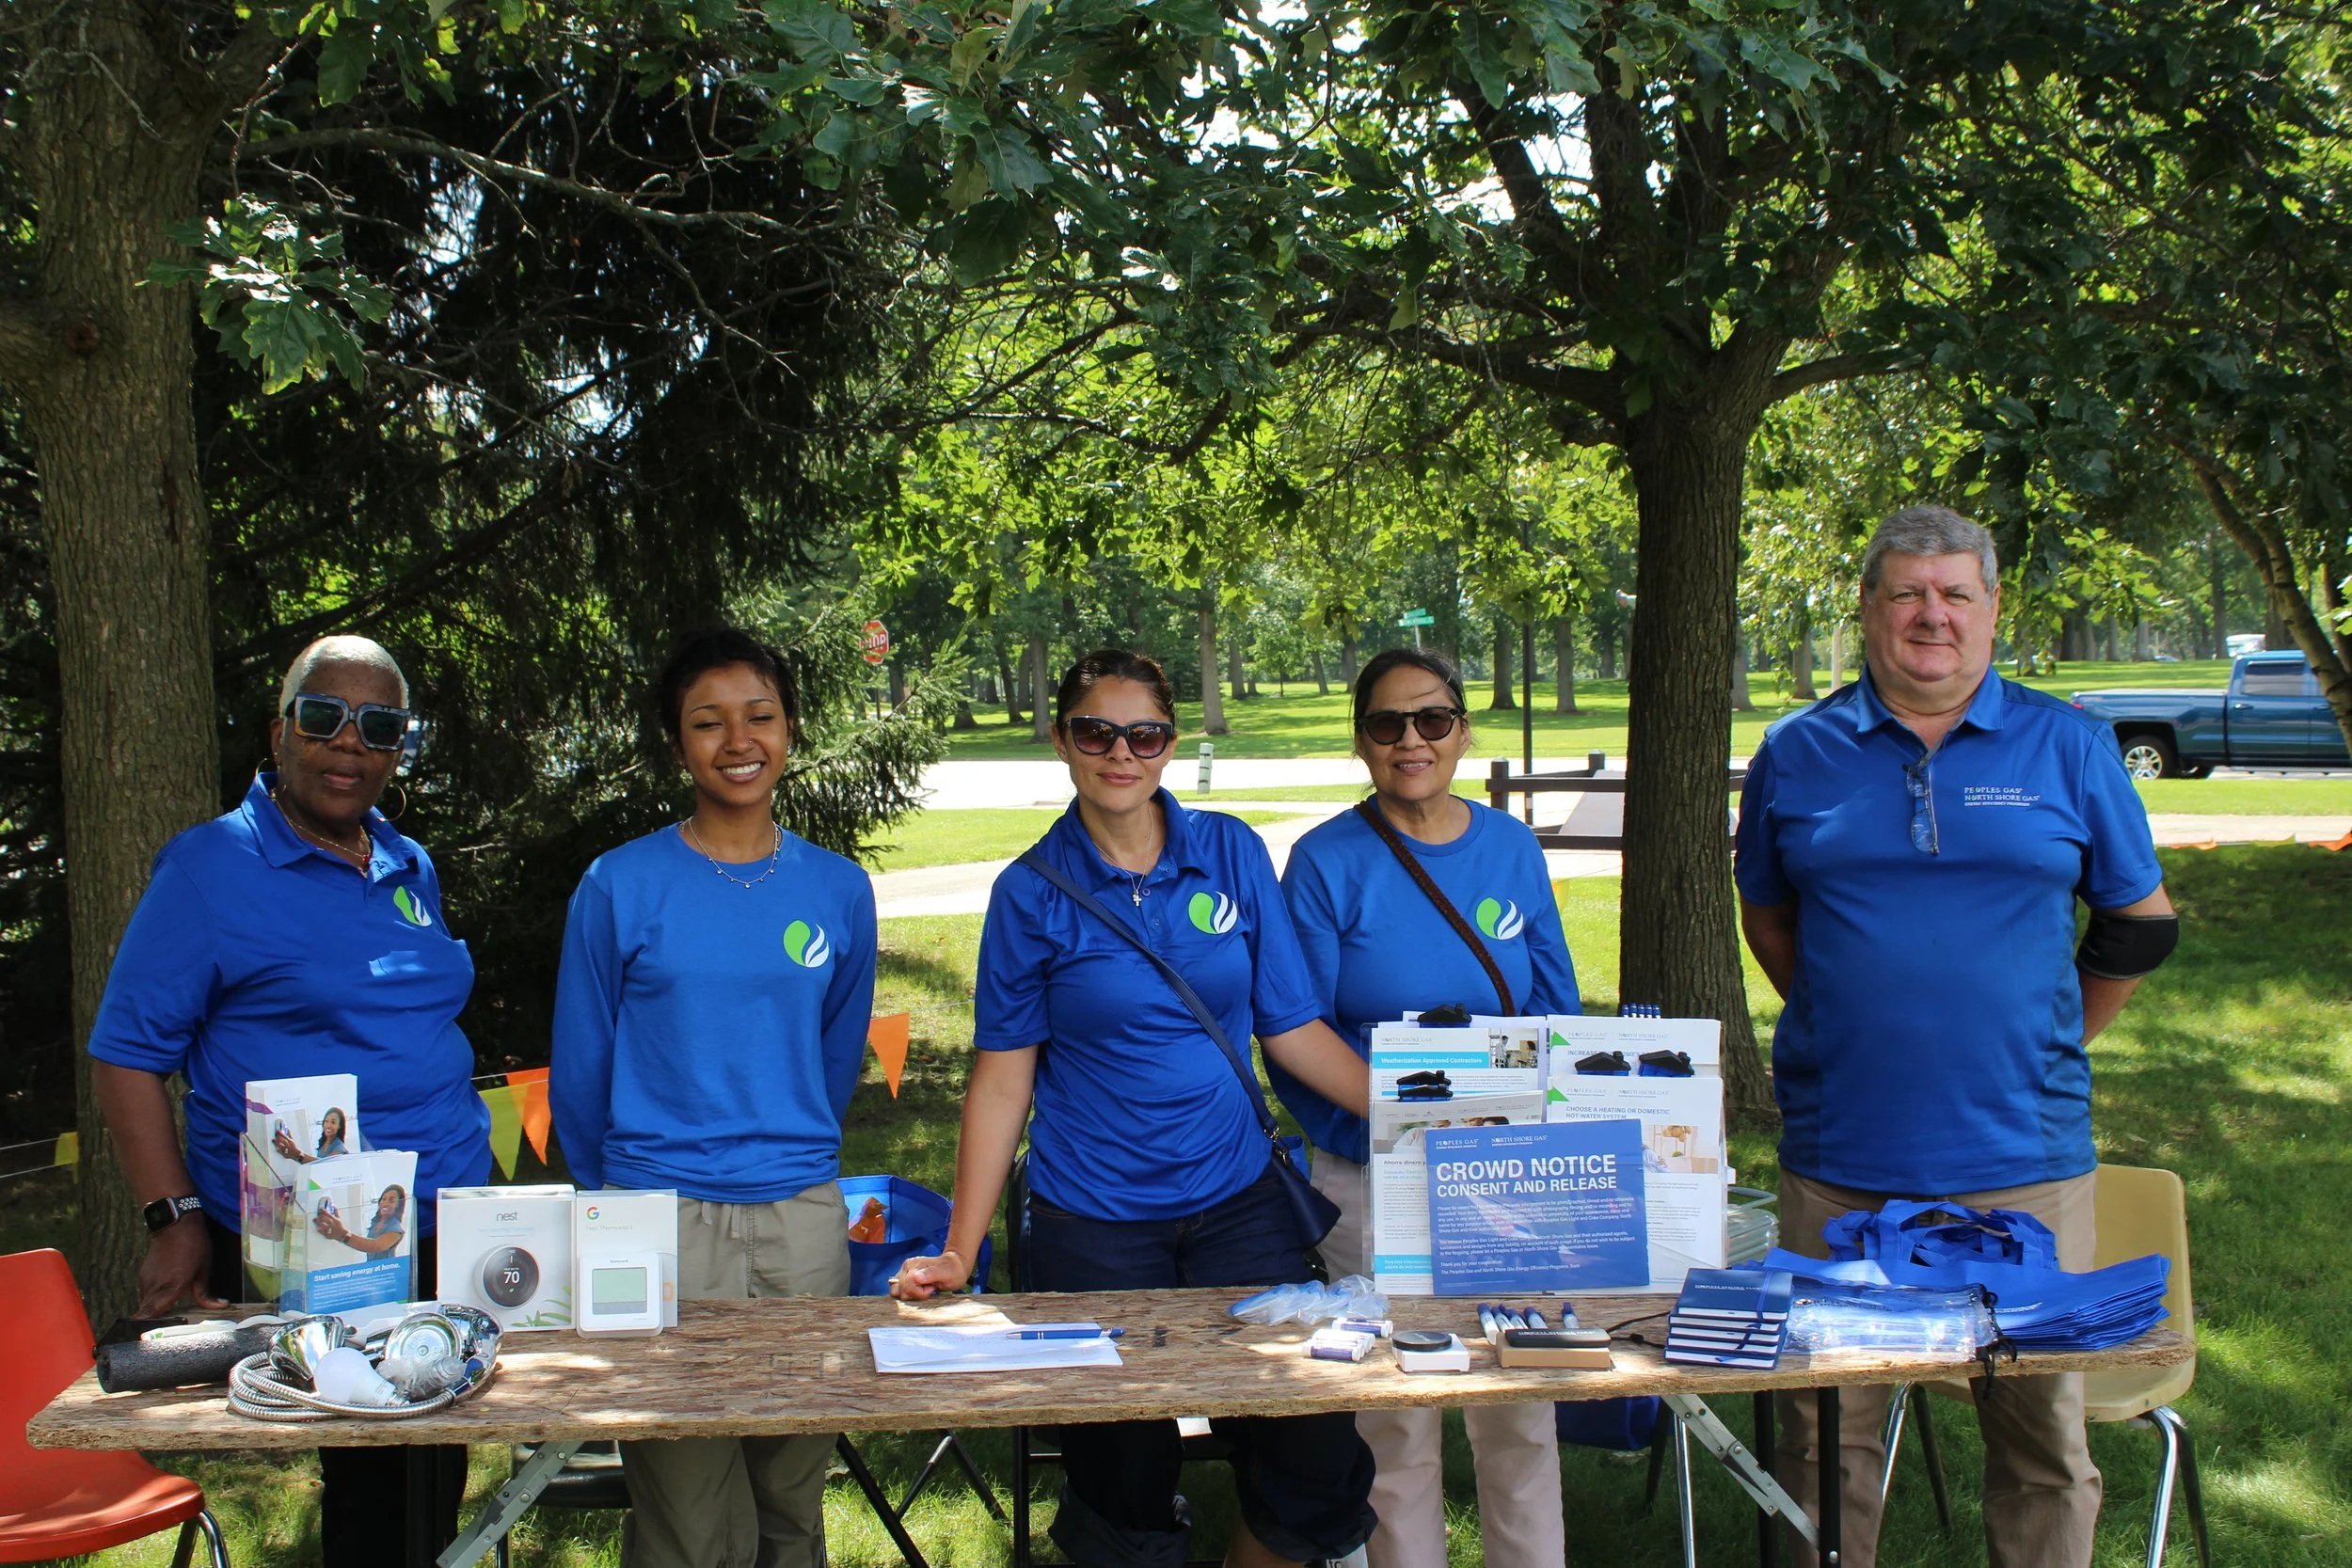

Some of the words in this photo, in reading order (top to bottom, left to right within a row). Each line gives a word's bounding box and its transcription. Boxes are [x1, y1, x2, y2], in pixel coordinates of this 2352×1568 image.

[1436, 1159, 1523, 1181] CROWD
[1531, 1154, 1616, 1177] NOTICE
[1438, 1181, 1509, 1197] CONSENT
[1513, 1180, 1546, 1194] AND
[1550, 1176, 1617, 1192] RELEASE
[497, 1212, 517, 1221] nest
[313, 1274, 329, 1282] Start
[331, 1271, 352, 1279] saving
[352, 1266, 373, 1275] energy
[382, 1262, 400, 1271] home.
[504, 1272, 519, 1283] 70
